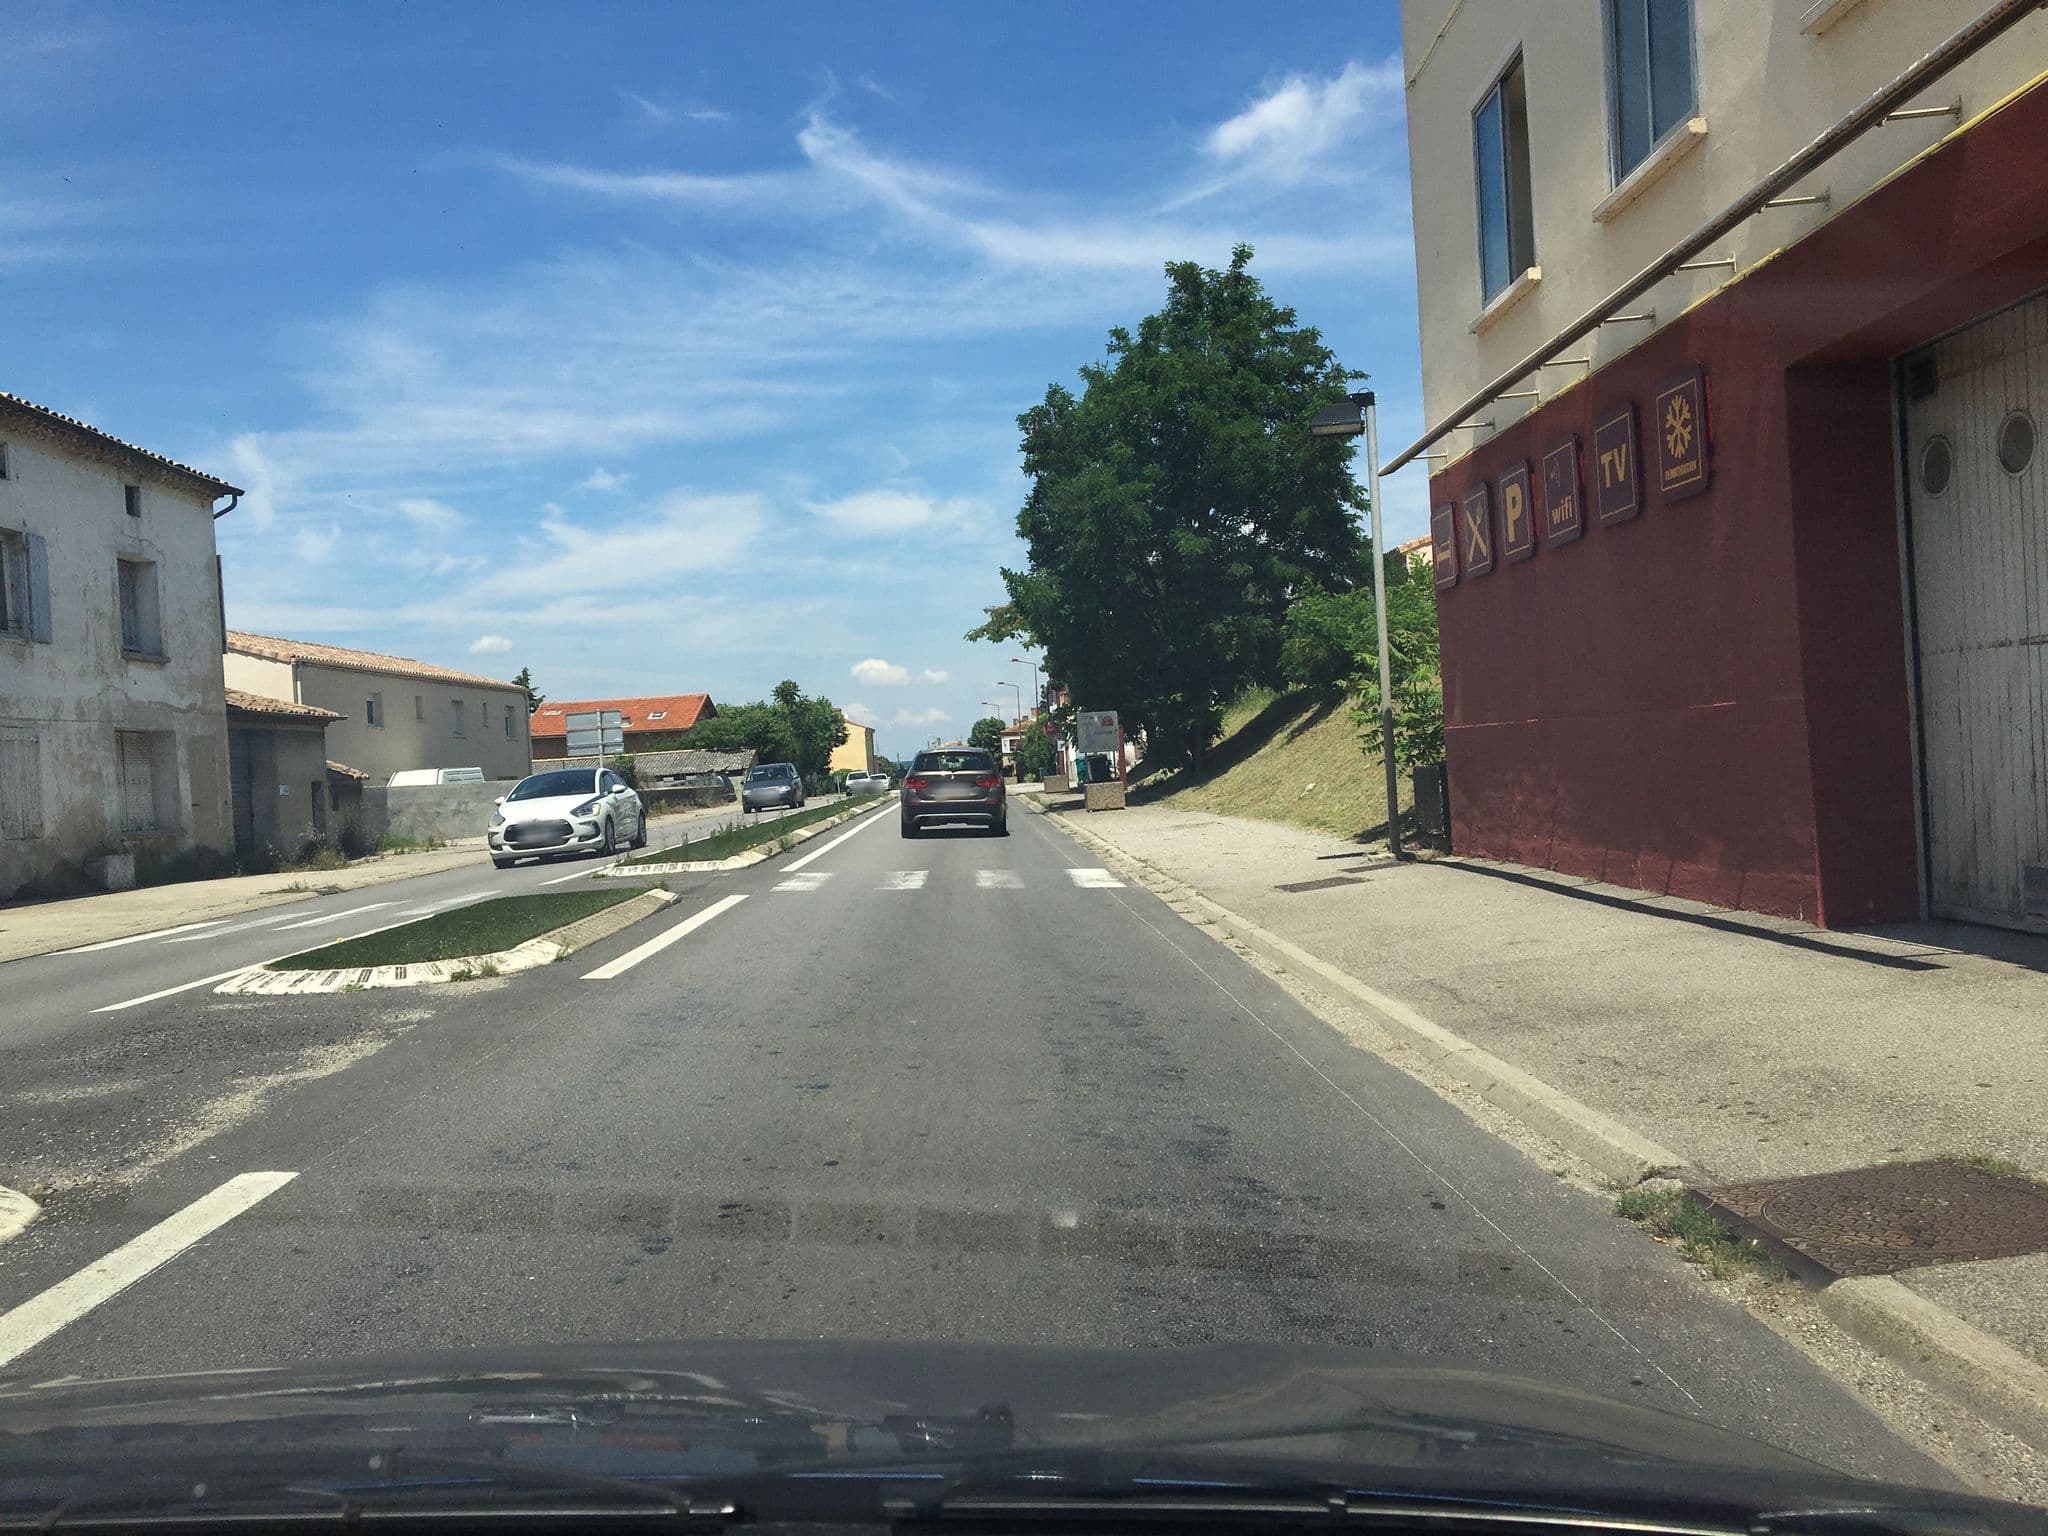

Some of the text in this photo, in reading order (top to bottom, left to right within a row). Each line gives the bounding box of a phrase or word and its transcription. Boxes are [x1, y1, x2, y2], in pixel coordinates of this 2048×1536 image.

[1600, 444, 1627, 488] TV
[1506, 483, 1523, 543] P
[1552, 496, 1573, 525] wifi
